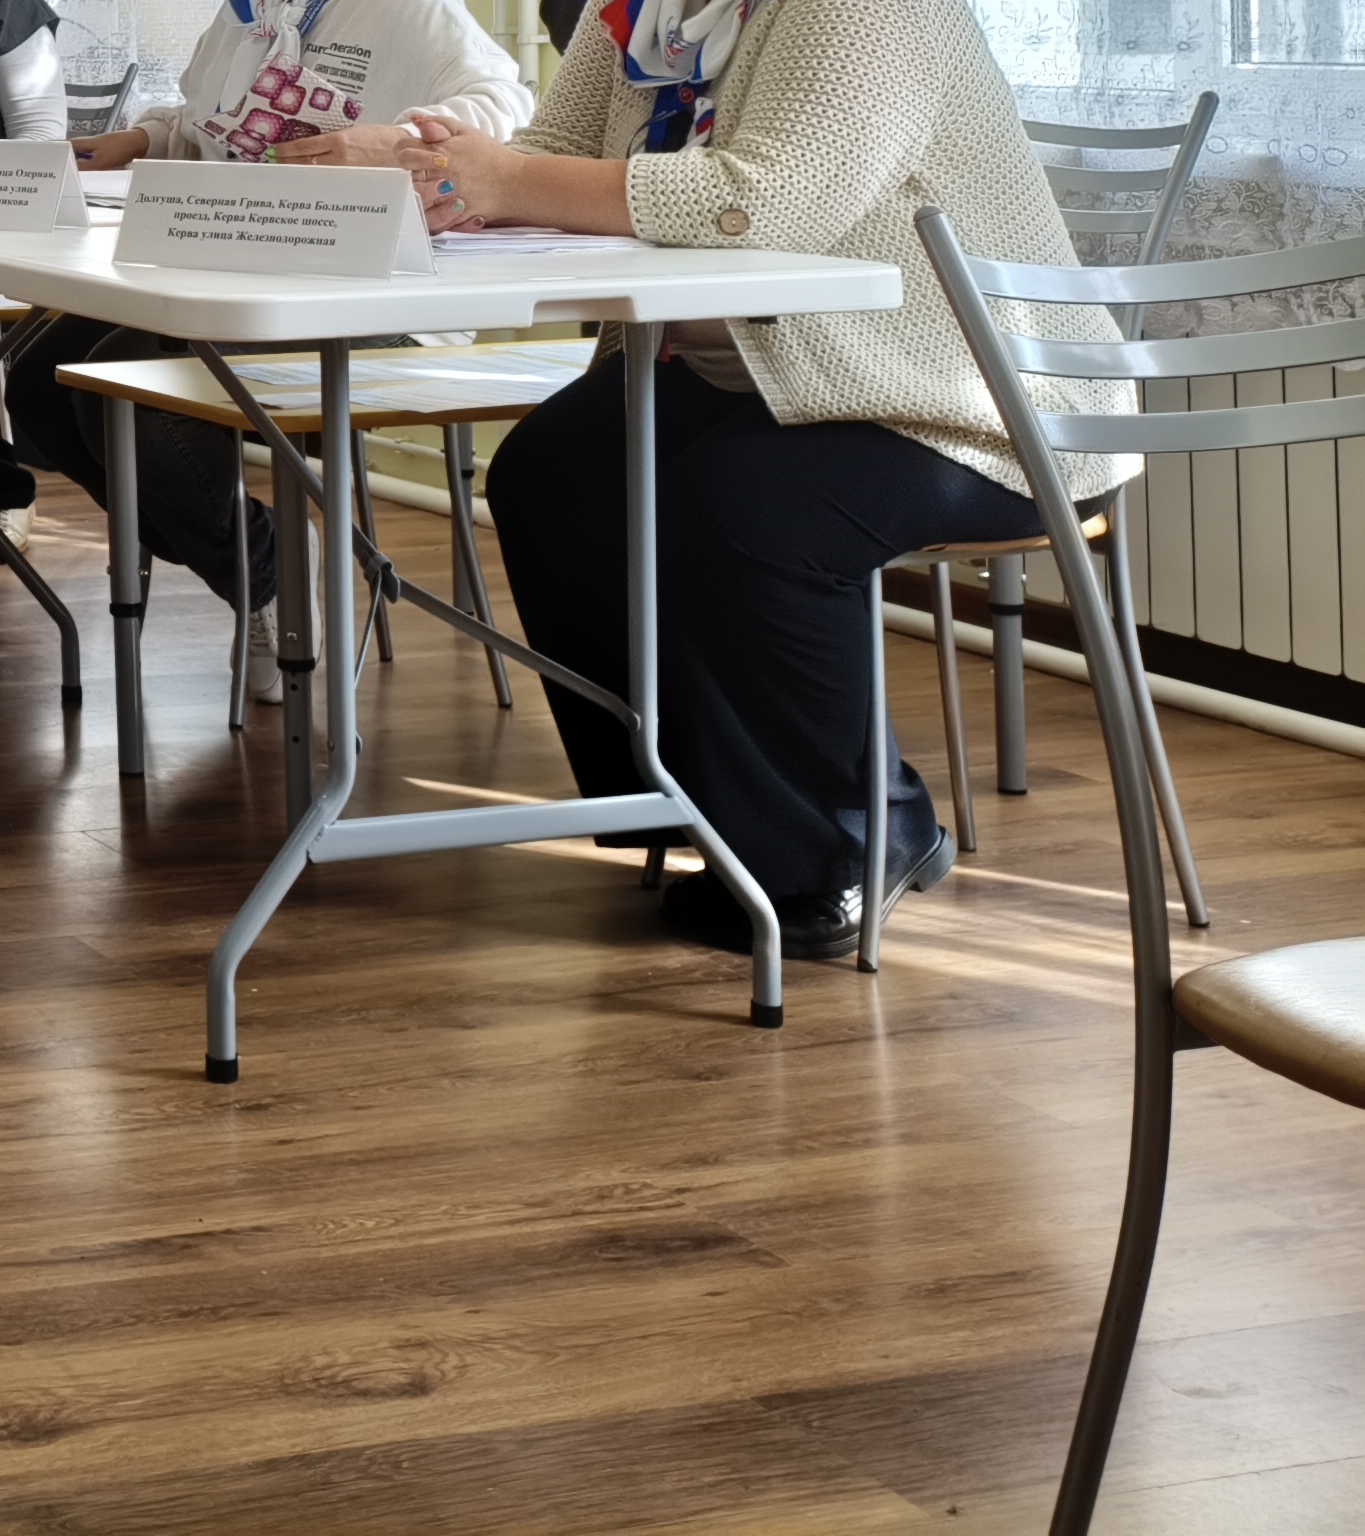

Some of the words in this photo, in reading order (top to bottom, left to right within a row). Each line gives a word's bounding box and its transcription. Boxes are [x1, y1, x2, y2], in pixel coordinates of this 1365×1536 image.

[9, 185, 38, 194] улица
[135, 192, 184, 205] Долгуша,
[186, 195, 237, 208] Северная
[239, 197, 275, 209] Грива,
[278, 199, 312, 211] Керва
[314, 200, 388, 214] Больничный
[174, 211, 210, 222] проезд,
[213, 211, 246, 224] Керва
[248, 212, 299, 226] Кервское
[301, 217, 338, 228] шоссе,
[167, 227, 199, 240] Керва
[200, 230, 233, 241] улица
[235, 230, 336, 246] Железнодорожная
